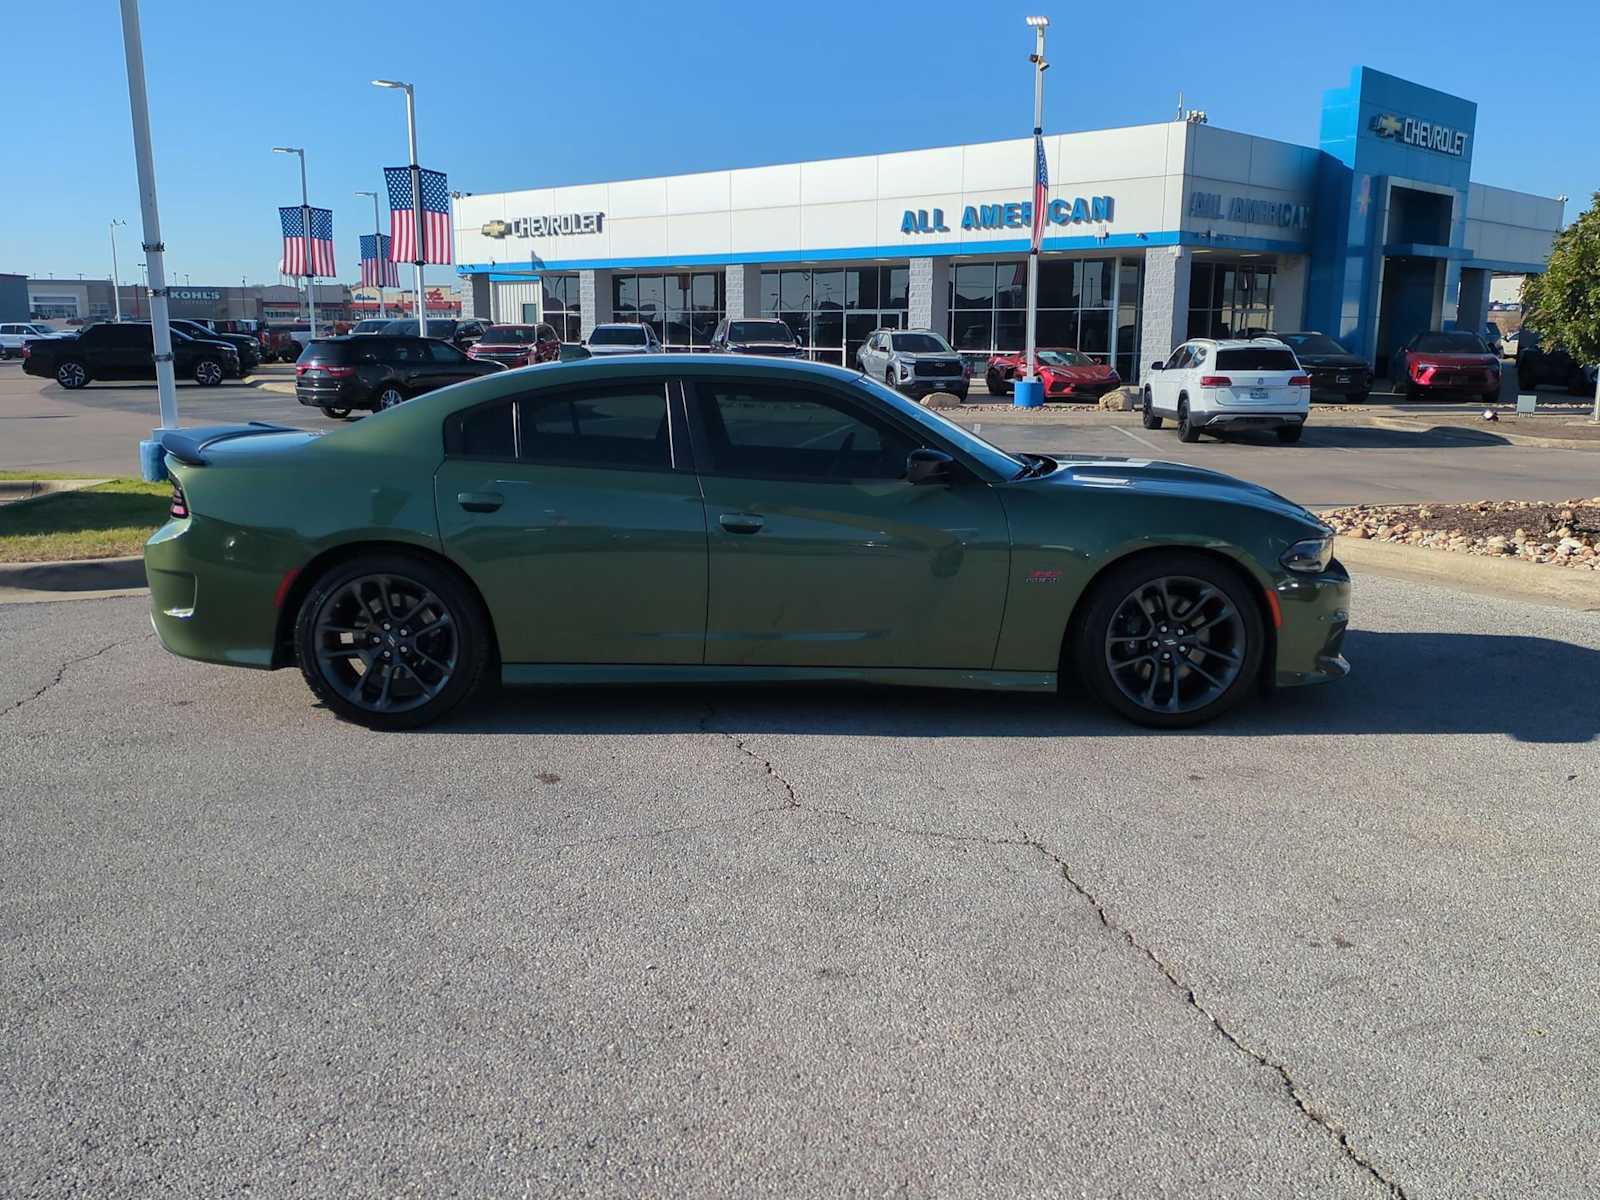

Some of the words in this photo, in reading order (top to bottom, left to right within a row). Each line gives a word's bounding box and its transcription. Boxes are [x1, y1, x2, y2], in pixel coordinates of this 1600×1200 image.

[1404, 117, 1469, 157] CHEVROLET
[511, 211, 605, 238] CHEVROLET
[900, 208, 950, 235] ALL
[961, 196, 1115, 231] AMERCAN
[169, 290, 222, 300] KOHL'S
